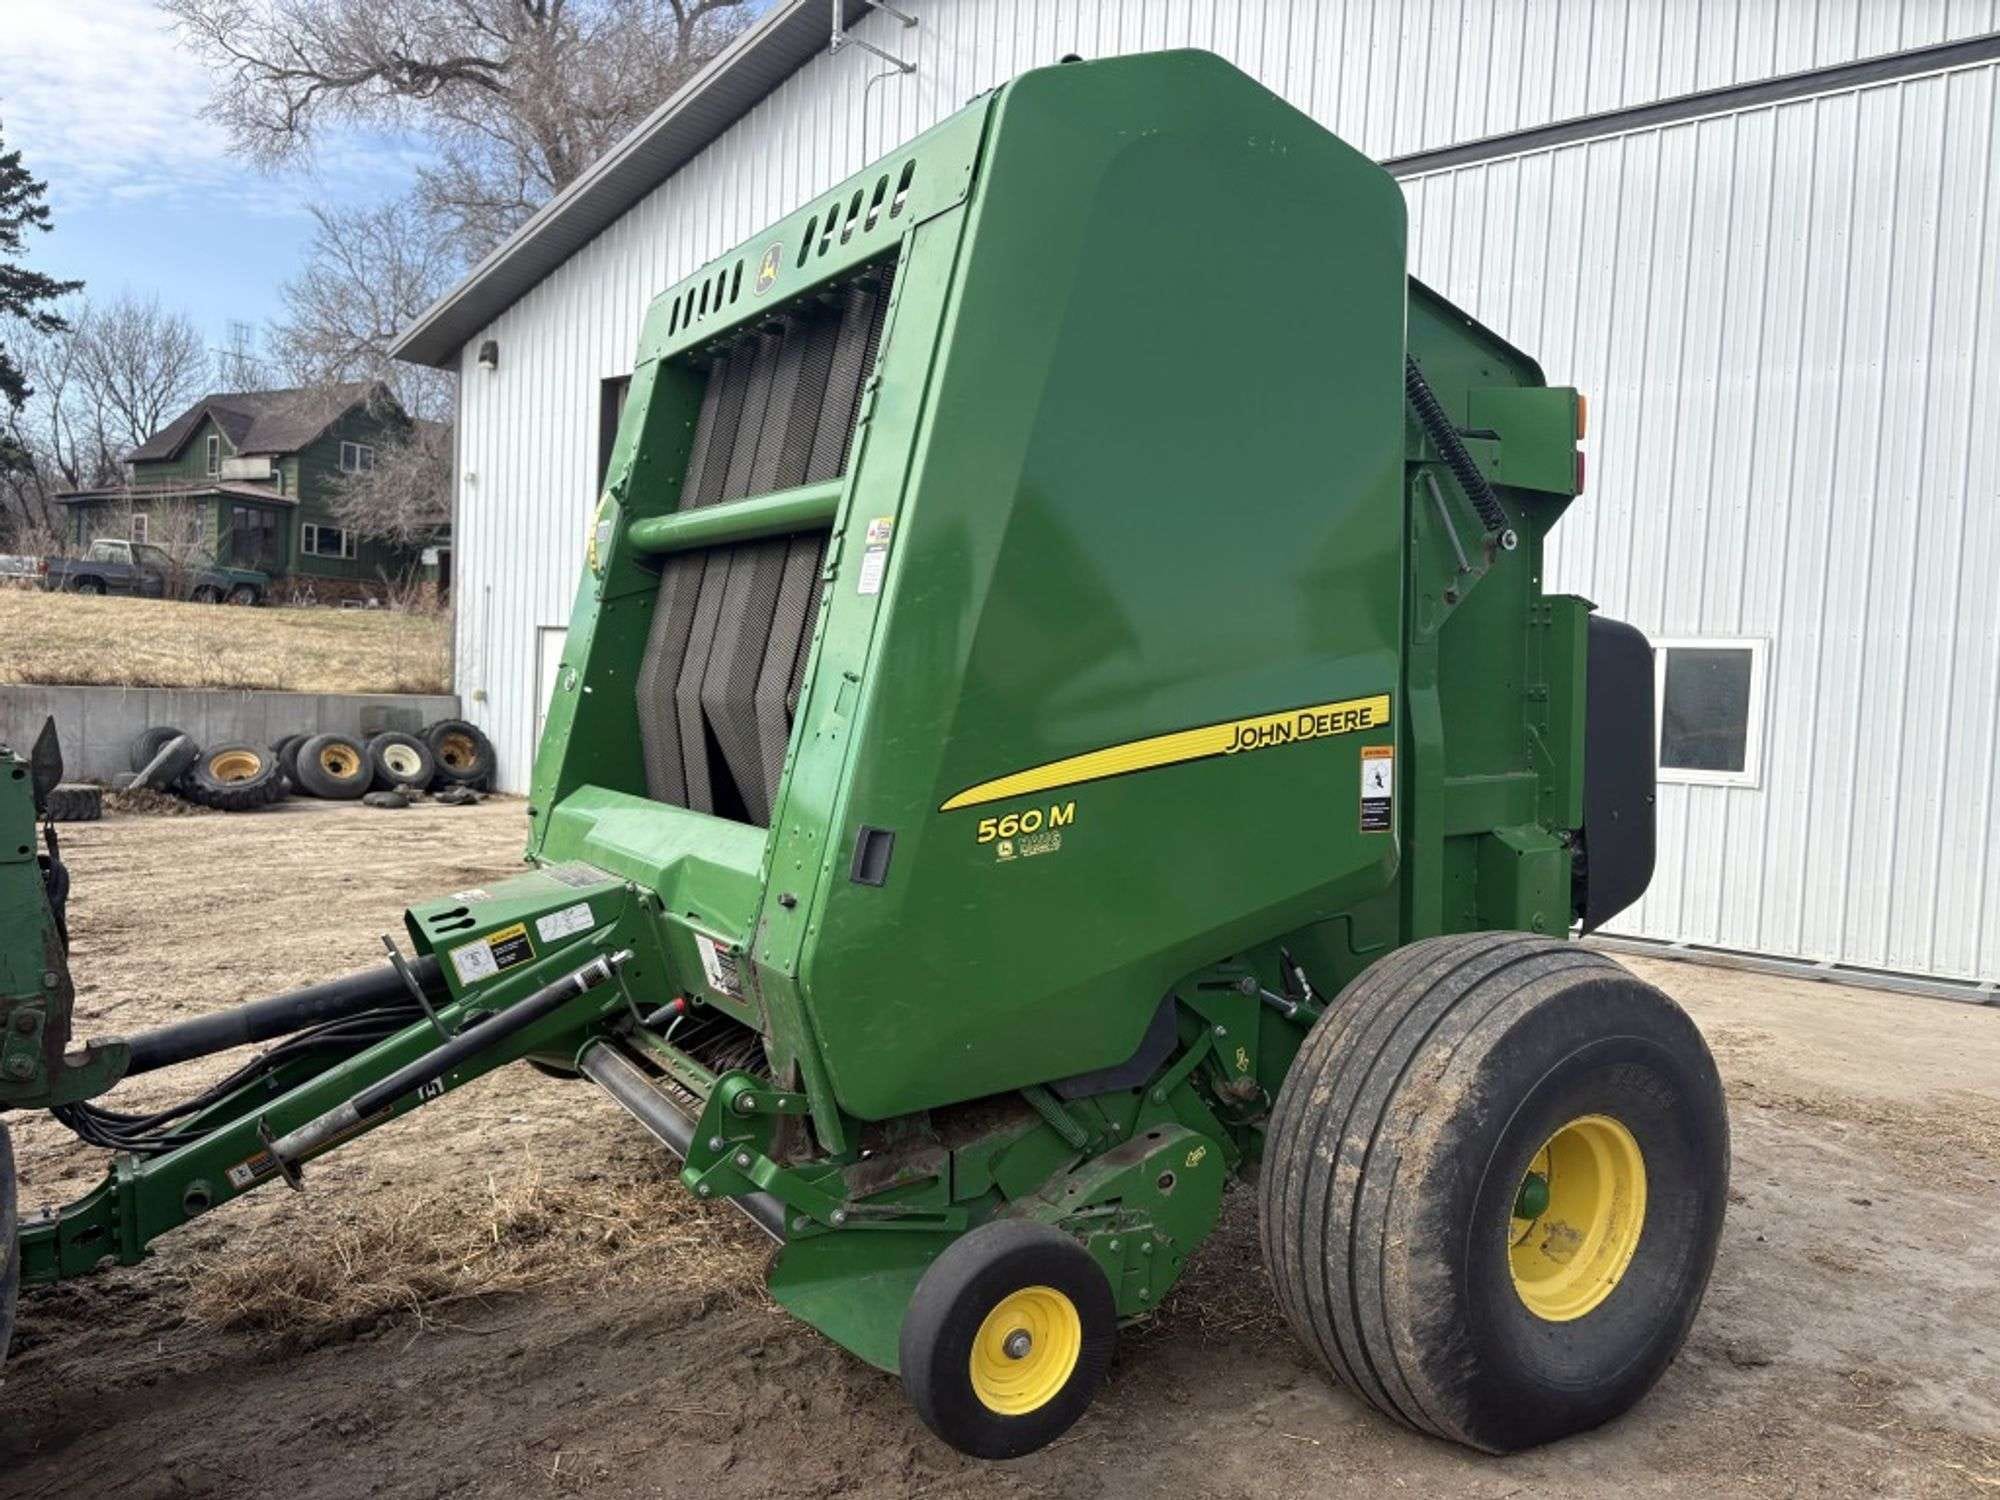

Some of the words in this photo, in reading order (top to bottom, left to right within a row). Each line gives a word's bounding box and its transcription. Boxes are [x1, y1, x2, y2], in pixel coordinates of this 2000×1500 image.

[1225, 720, 1292, 751] JOHN
[1297, 706, 1373, 737] DEERE
[977, 808, 1043, 844] 560
[1047, 800, 1076, 829] M
